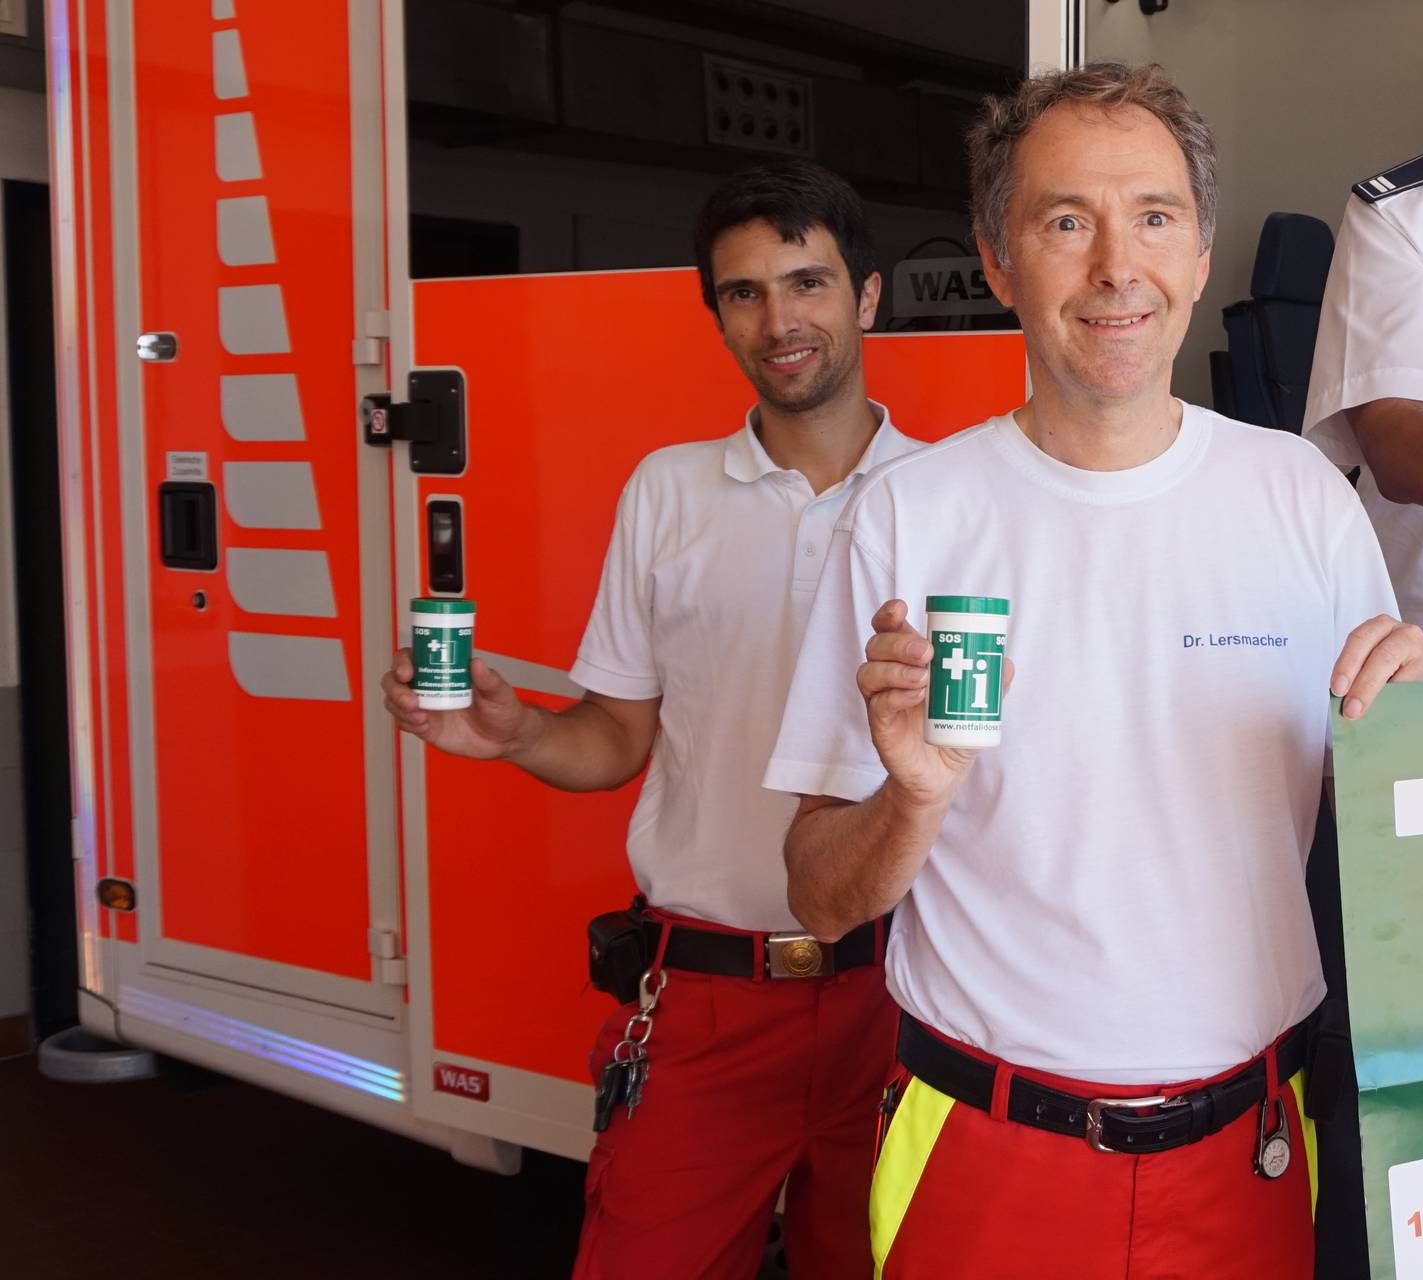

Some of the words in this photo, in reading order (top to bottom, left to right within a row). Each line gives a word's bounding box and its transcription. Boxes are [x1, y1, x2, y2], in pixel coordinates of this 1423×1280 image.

[909, 270, 992, 302] WAS
[938, 633, 962, 643] SOS
[1183, 635, 1204, 648] Dr.
[1209, 633, 1288, 647] Lersmacher
[440, 1070, 481, 1094] WAS
[1407, 1211, 1422, 1237] 1
